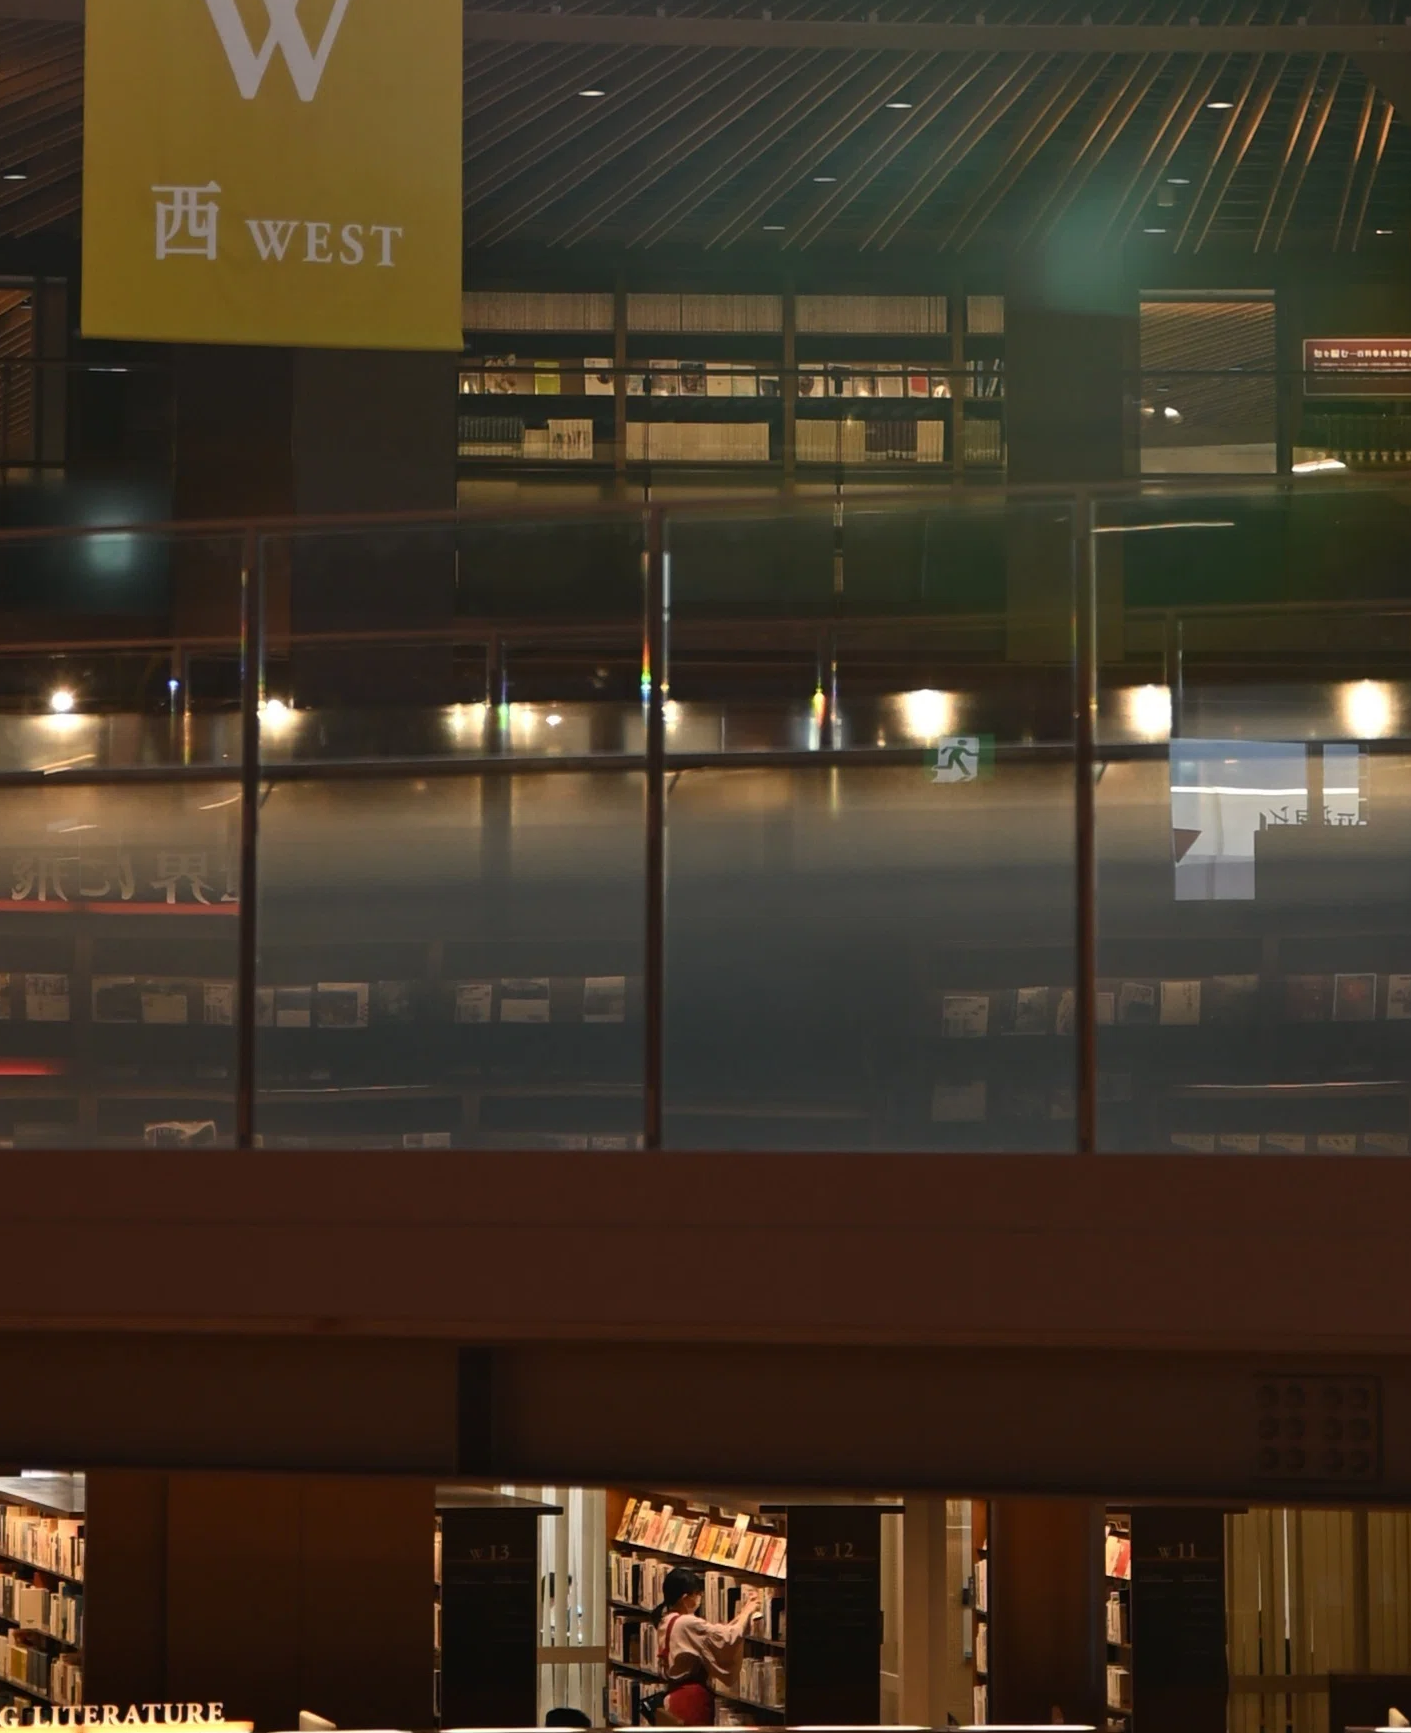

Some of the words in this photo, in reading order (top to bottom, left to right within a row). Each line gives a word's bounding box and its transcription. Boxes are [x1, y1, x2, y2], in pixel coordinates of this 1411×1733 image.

[150, 180, 222, 262] 西
[244, 218, 404, 268] WEST
[33, 1700, 226, 1729] LITERATURE
